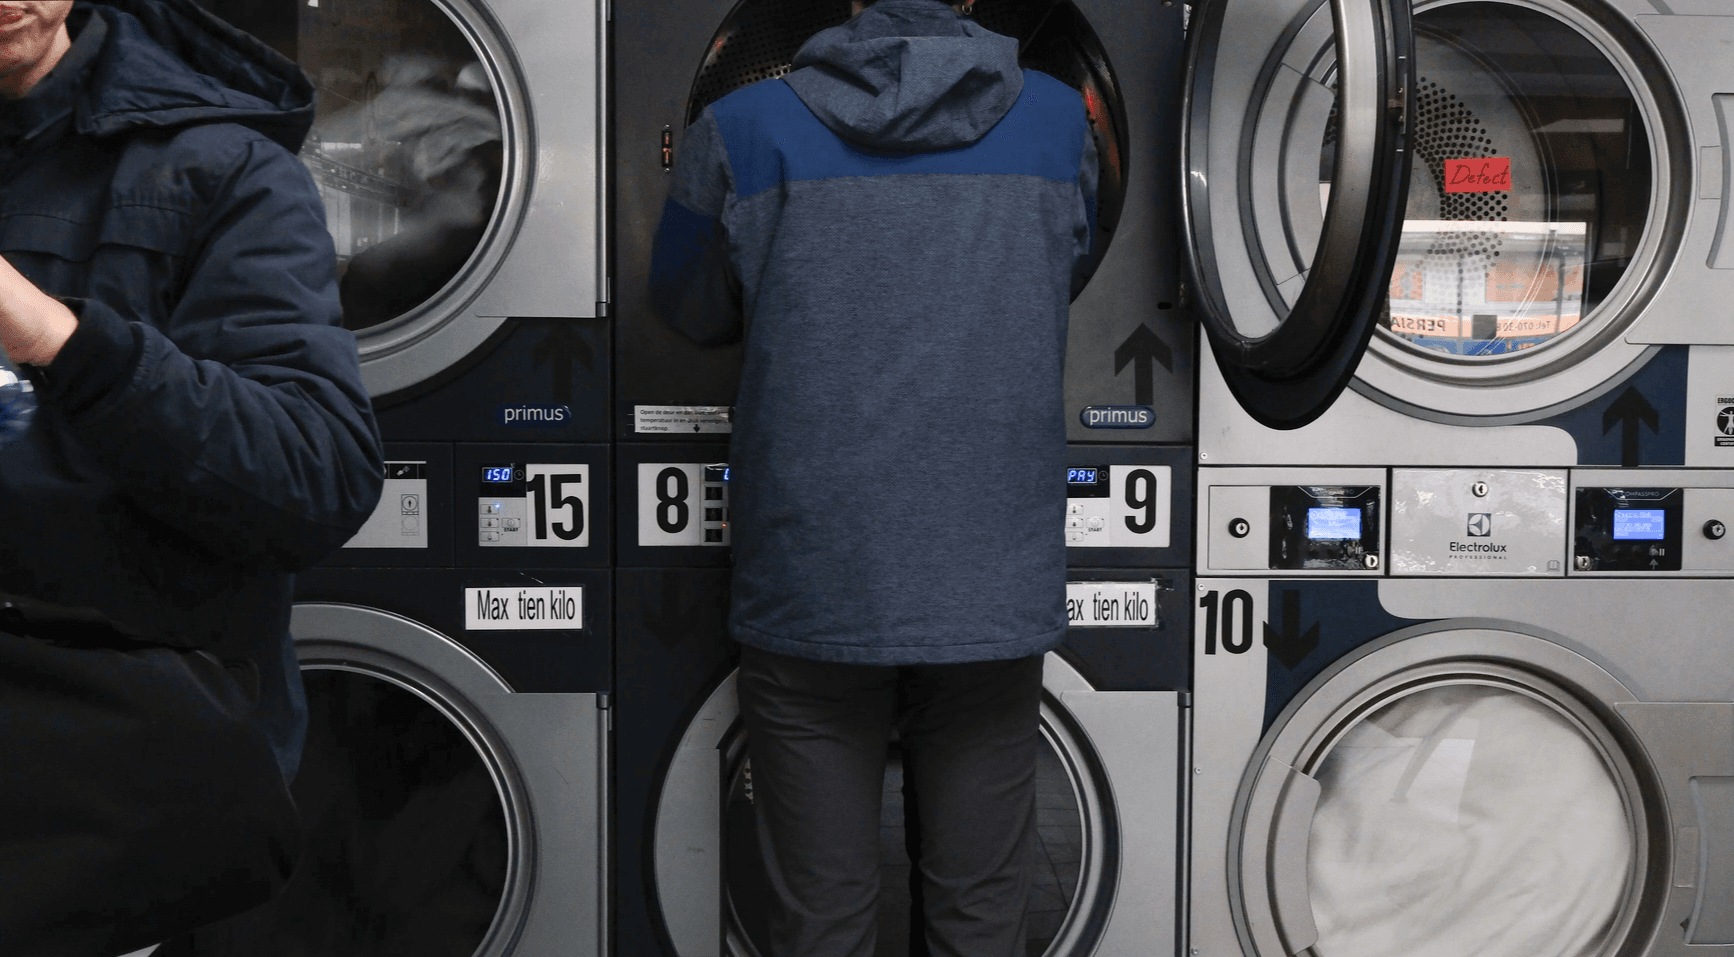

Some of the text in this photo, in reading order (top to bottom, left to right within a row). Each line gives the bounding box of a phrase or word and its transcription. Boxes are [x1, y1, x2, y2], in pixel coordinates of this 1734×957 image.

[1450, 163, 1508, 185] Defect
[504, 405, 565, 425] primus
[1089, 407, 1148, 426] primus
[486, 468, 511, 481] 150
[526, 474, 584, 541] 15
[656, 467, 689, 534] 8
[1125, 468, 1157, 534] 9
[1449, 541, 1507, 553] Electrolux
[477, 590, 576, 621] Max tien kilo
[1066, 592, 1149, 621] ax tien kilo
[1199, 589, 1254, 655] 10
